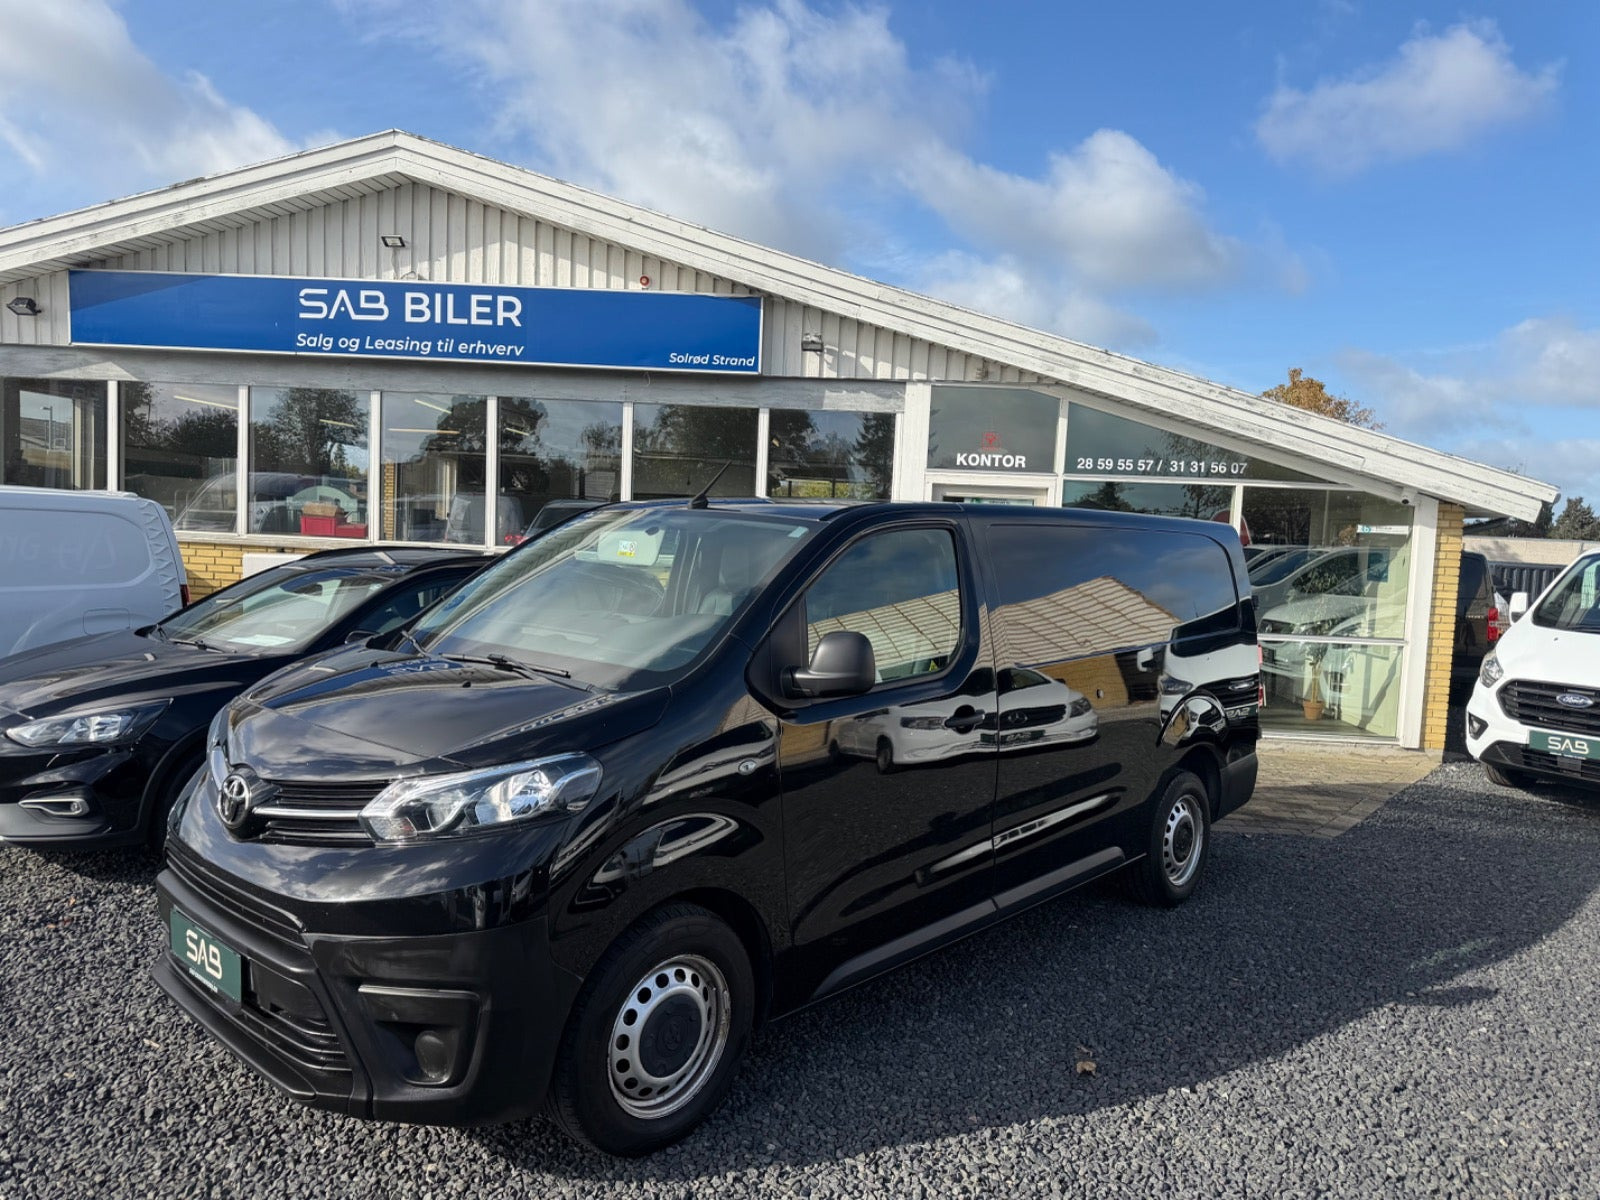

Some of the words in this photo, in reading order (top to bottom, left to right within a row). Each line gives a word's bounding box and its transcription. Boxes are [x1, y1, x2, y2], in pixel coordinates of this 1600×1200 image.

[299, 288, 390, 321] SAB
[405, 292, 522, 327] BILER
[296, 333, 334, 351] Salg
[338, 337, 360, 351] og
[365, 336, 432, 355] Leasing
[437, 338, 454, 353] til
[458, 341, 524, 356] erhverv
[669, 352, 710, 364] Solrød
[712, 354, 755, 366] Strand
[956, 453, 1026, 468] KONTOR
[1077, 457, 1093, 470] 28
[1097, 458, 1113, 470] 59
[1117, 458, 1134, 471] 55
[1137, 459, 1154, 471] 57
[1169, 460, 1185, 473] 31
[1190, 461, 1205, 473] 31
[1210, 462, 1227, 474] 56
[1230, 462, 1248, 474] 07
[1547, 736, 1589, 755] SAB
[186, 929, 223, 980] SAB
